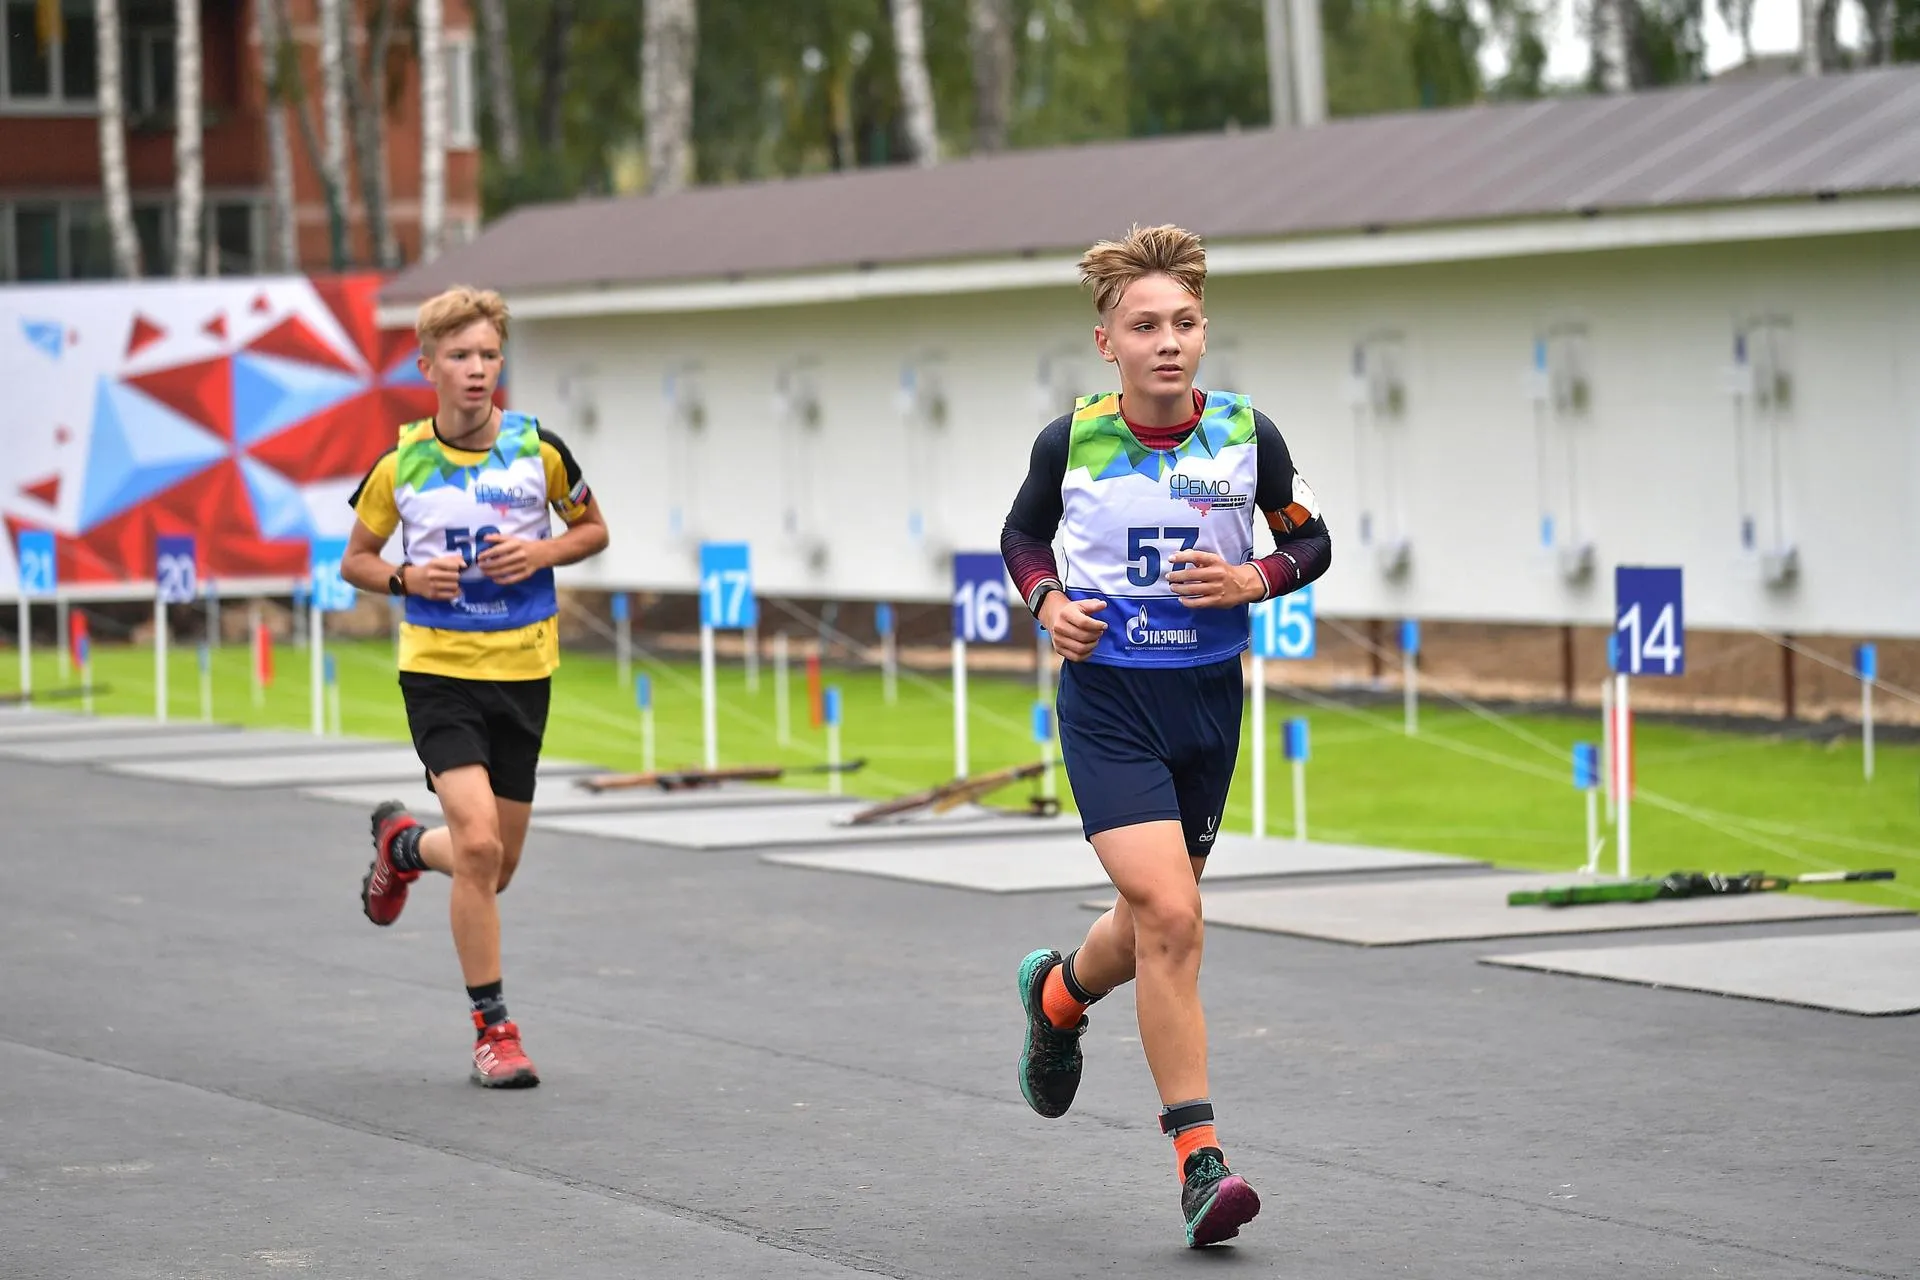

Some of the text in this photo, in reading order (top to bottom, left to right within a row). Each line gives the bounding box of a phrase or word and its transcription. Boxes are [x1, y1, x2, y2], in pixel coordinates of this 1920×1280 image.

[1170, 474, 1230, 496] ФБМО
[20, 550, 53, 591] 21
[158, 554, 196, 604] 20
[1126, 527, 1199, 586] 57
[705, 570, 748, 624] 17
[954, 581, 1008, 641] 16
[1149, 630, 1197, 644] ГАЗФОНД
[1255, 594, 1310, 656] 15
[1617, 602, 1681, 674] 14
